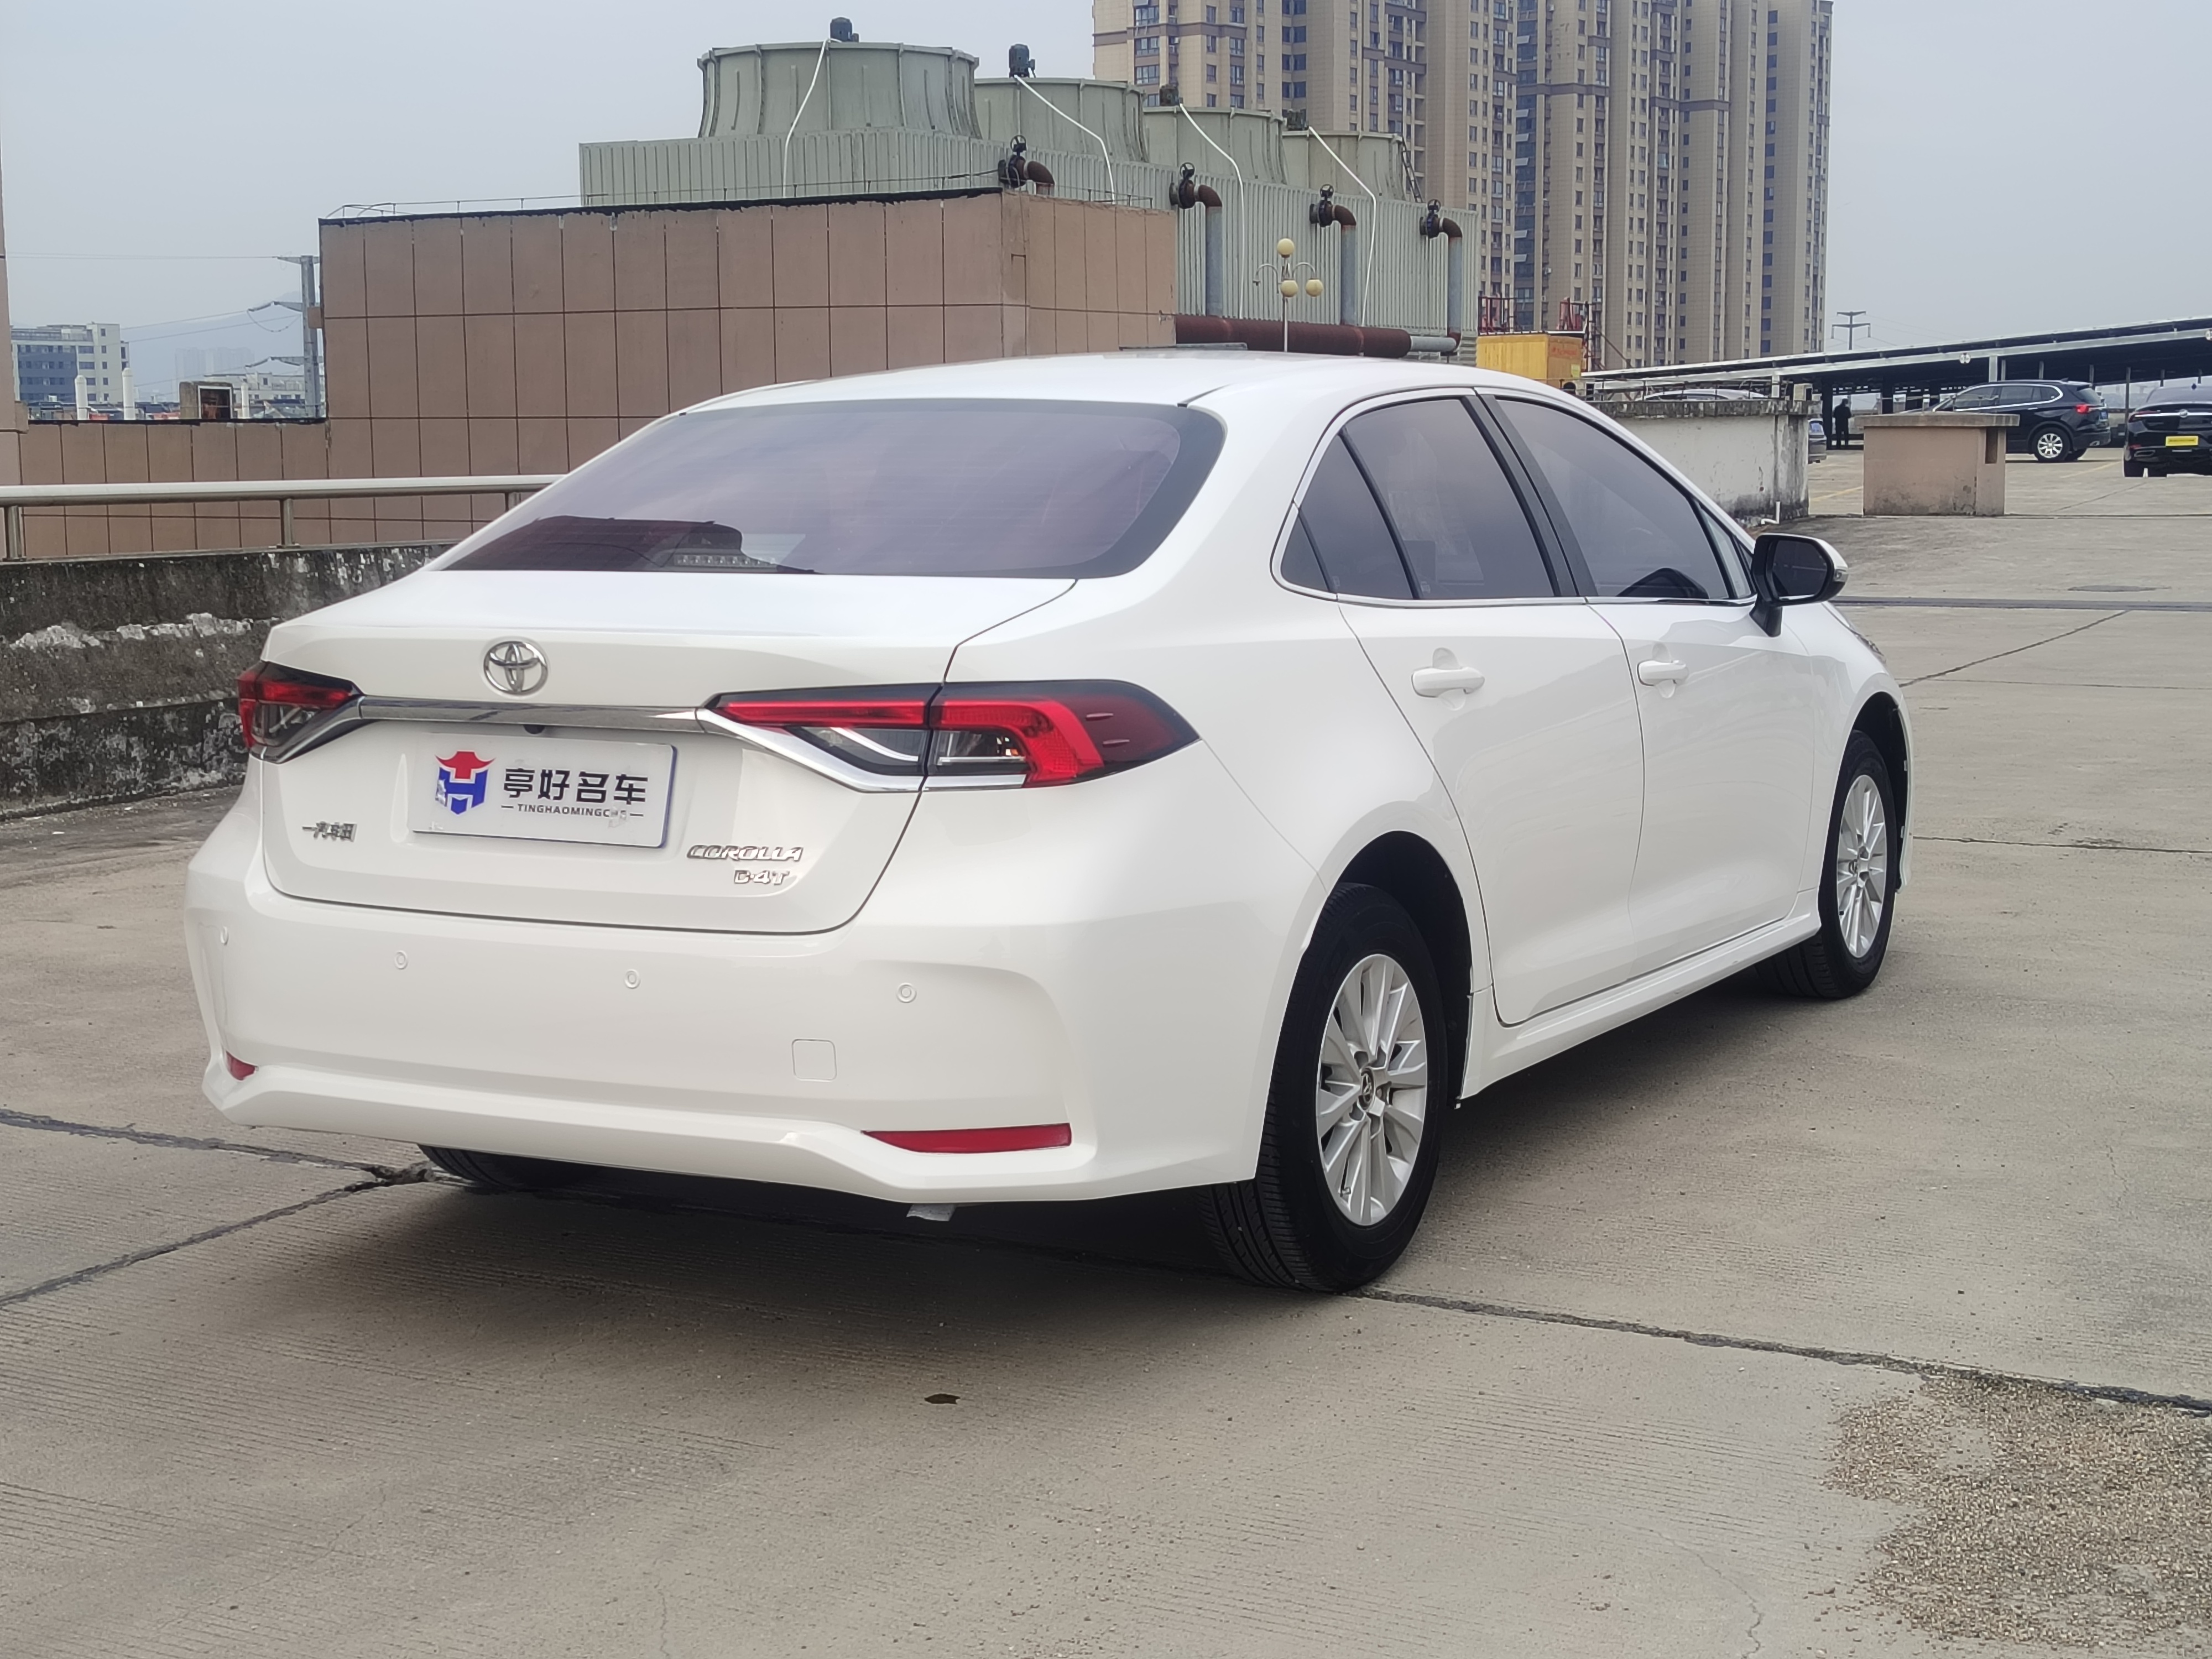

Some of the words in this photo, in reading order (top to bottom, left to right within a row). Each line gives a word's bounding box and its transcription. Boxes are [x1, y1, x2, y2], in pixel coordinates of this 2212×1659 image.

[503, 768, 648, 805] 亭好名车
[687, 844, 804, 862] COROLLA
